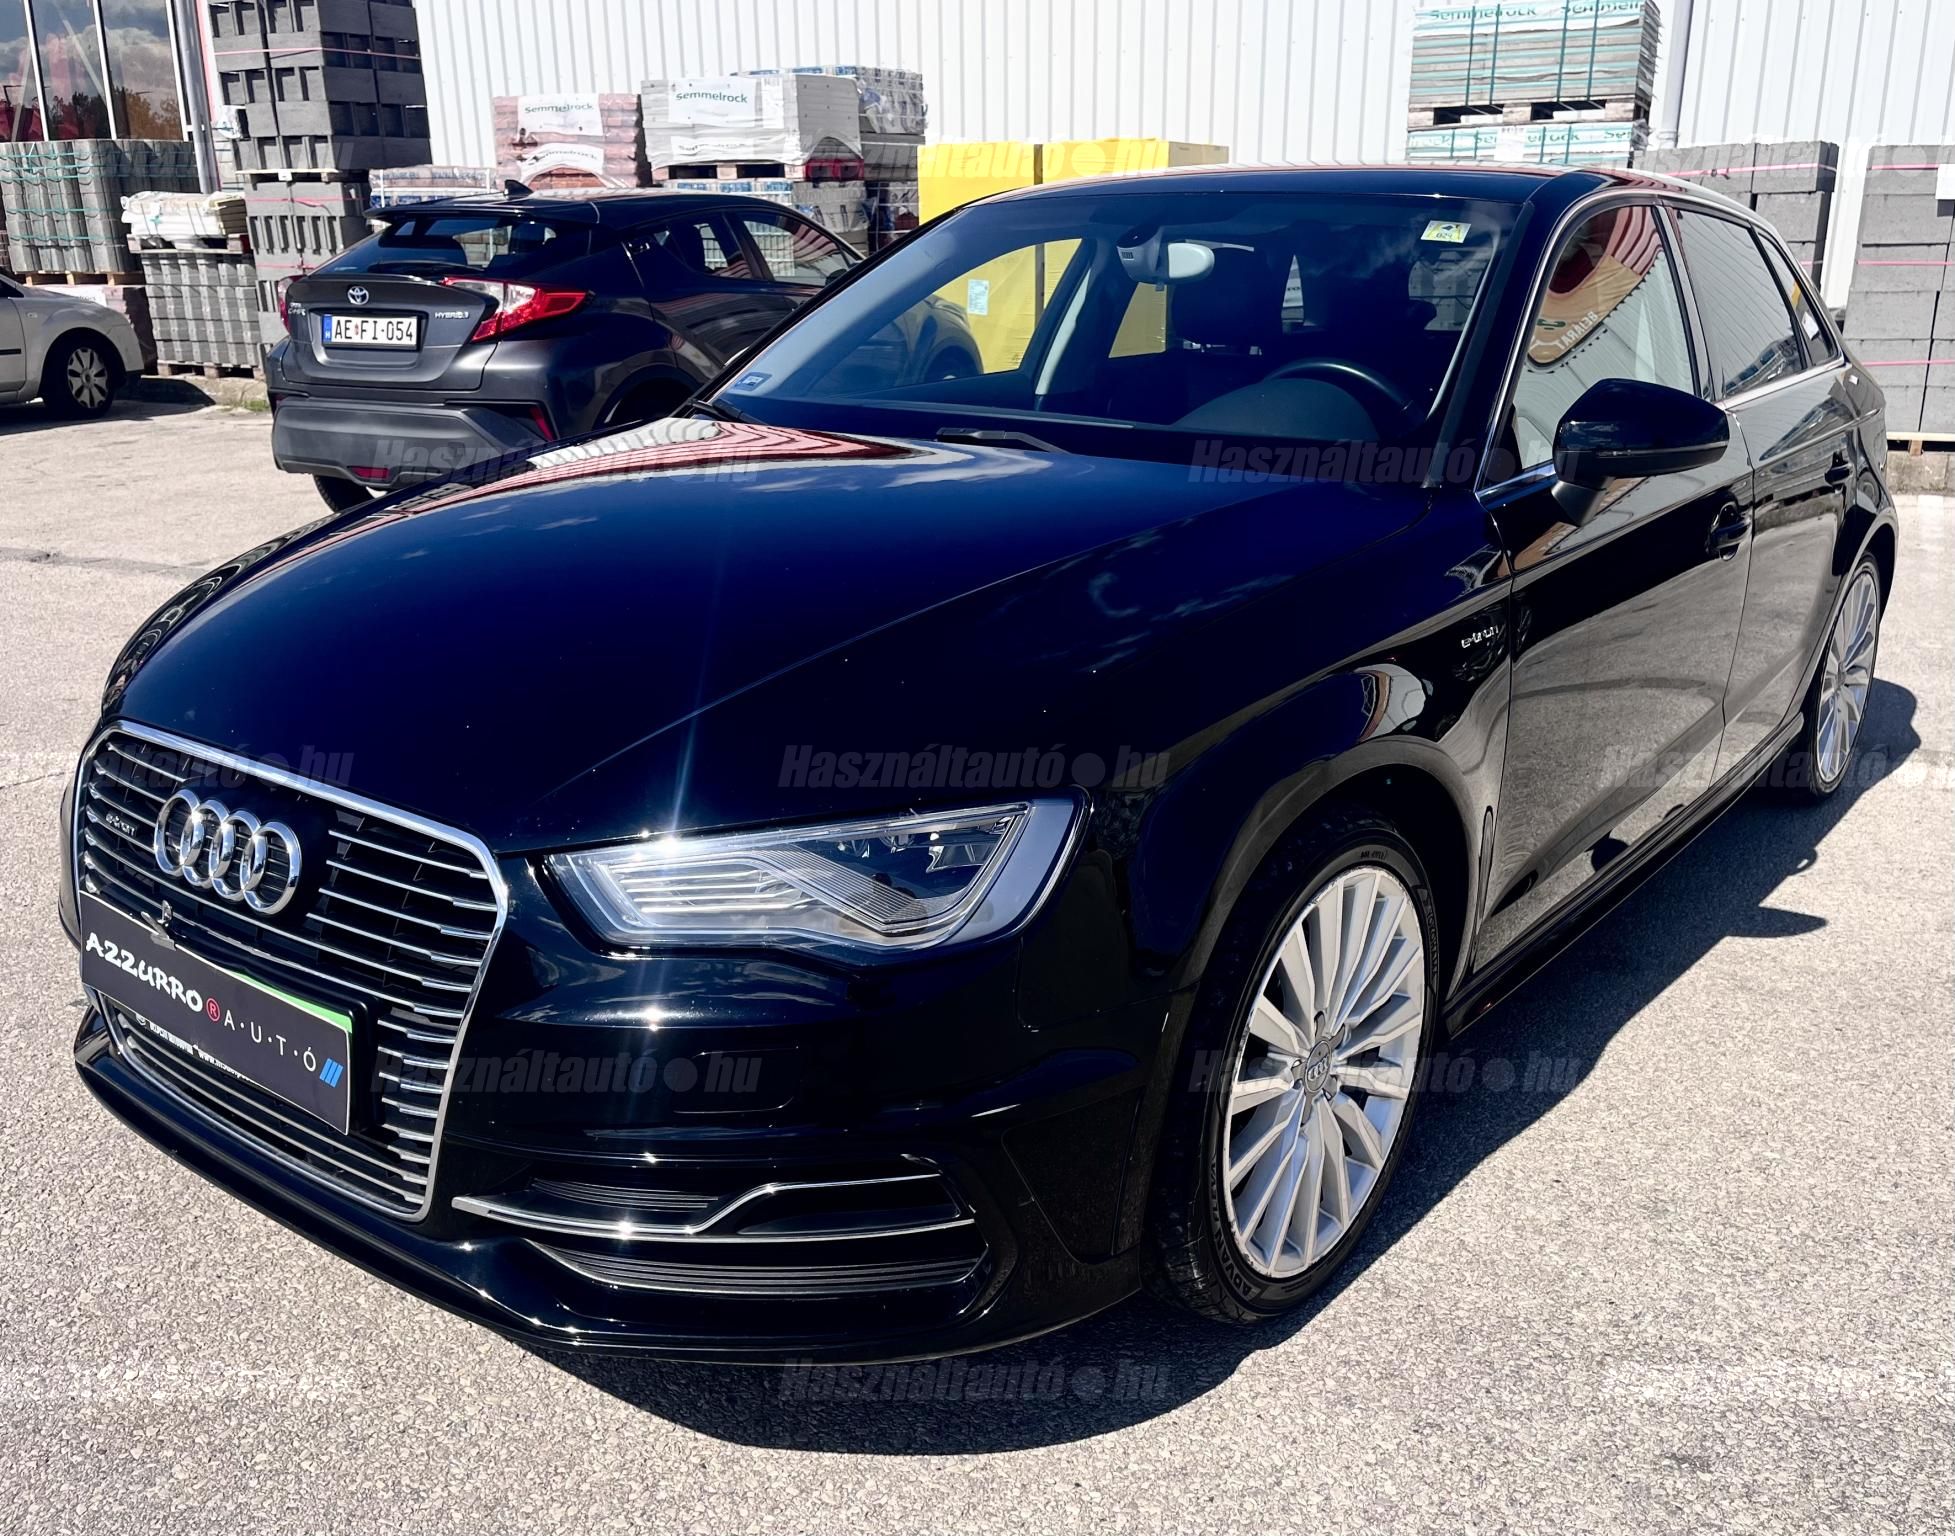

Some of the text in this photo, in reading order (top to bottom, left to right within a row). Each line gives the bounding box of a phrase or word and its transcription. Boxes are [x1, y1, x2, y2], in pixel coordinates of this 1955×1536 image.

[676, 91, 748, 104] semmelrock
[334, 319, 353, 340] AE
[360, 320, 413, 342] FI-054
